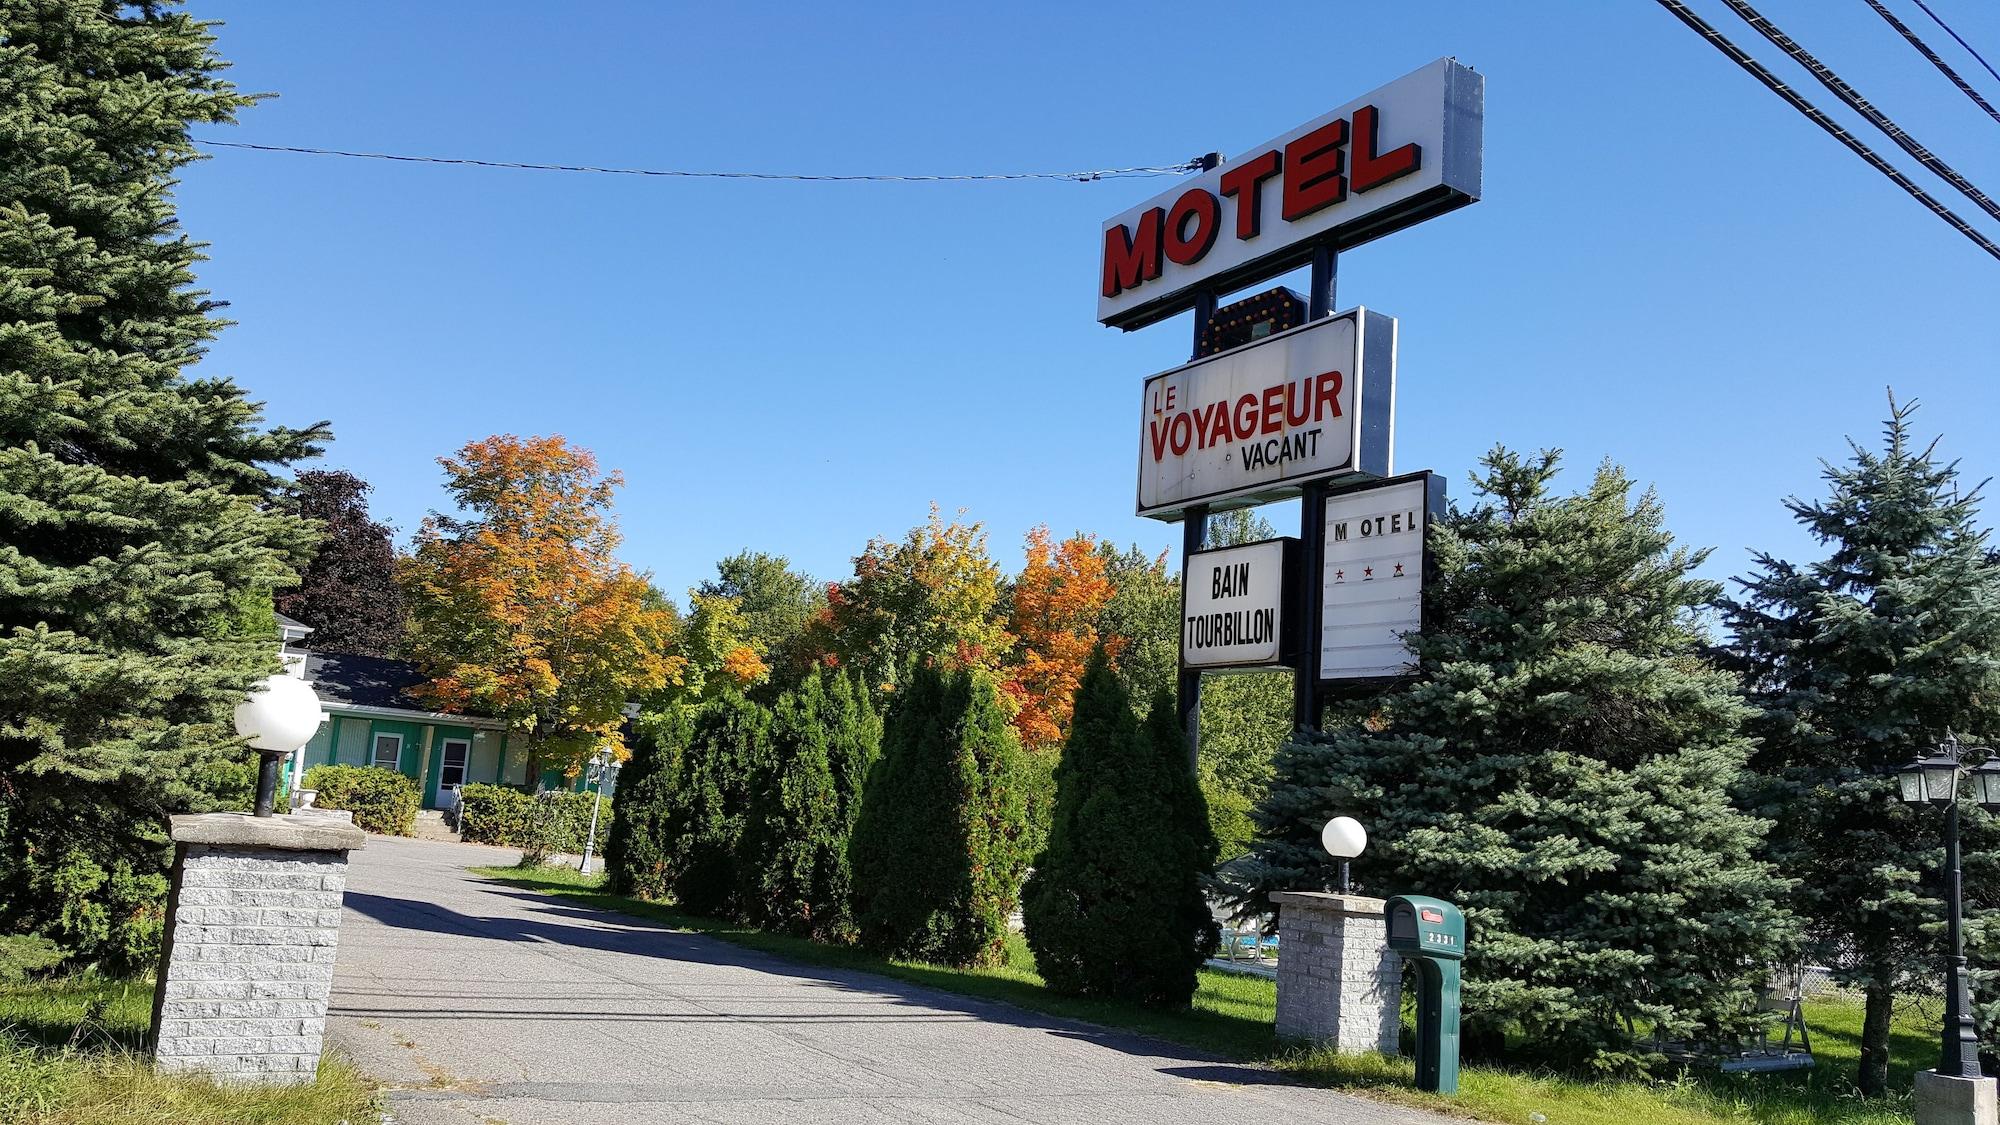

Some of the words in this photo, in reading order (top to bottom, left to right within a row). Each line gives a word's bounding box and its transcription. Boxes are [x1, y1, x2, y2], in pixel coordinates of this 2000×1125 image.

[1103, 105, 1421, 297] MOTEL
[1151, 370, 1342, 462] VOYAGEUR
[1154, 386, 1176, 414] LE
[1242, 429, 1321, 470] VACANT
[1335, 512, 1415, 540] MOTEL
[1212, 562, 1249, 599] BAIN
[1188, 608, 1274, 648] TOURBILLON
[1429, 933, 1454, 945] 2331
